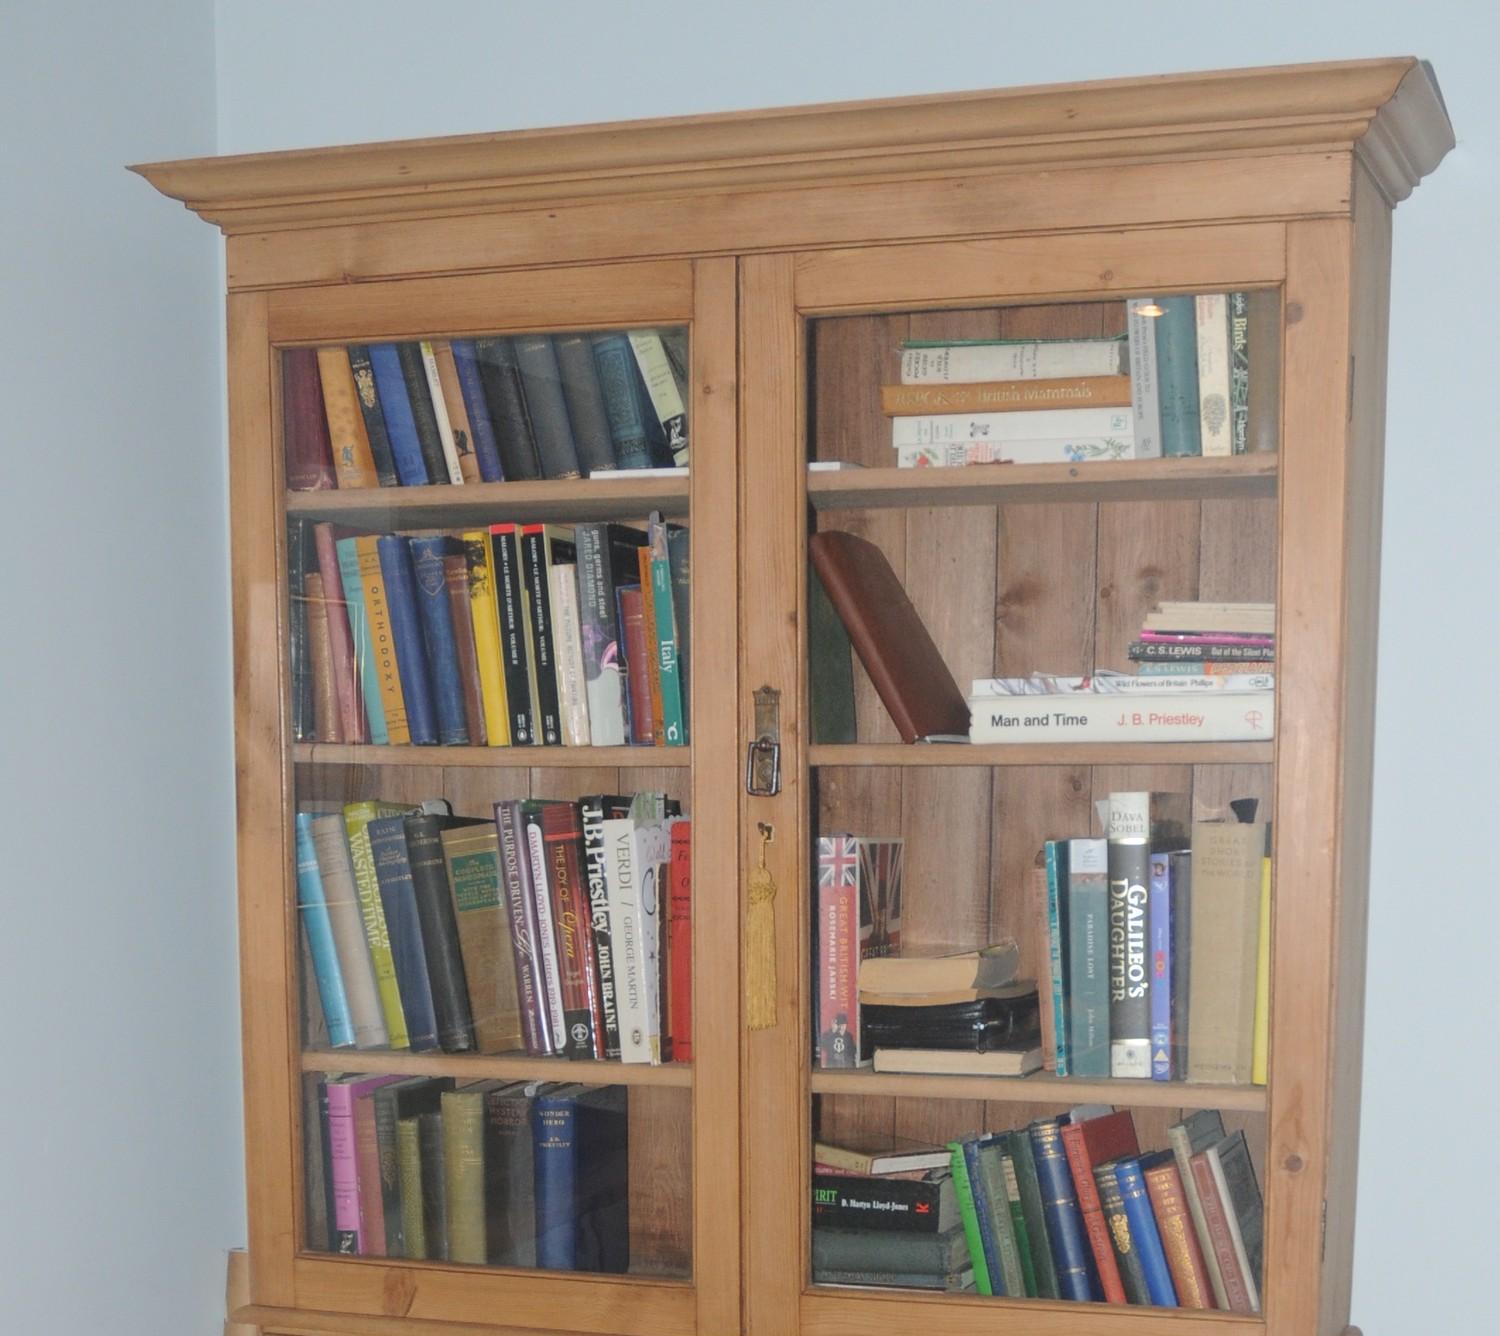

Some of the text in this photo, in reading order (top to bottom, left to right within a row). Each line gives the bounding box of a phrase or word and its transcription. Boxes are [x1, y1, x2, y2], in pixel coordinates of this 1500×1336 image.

[1233, 317, 1248, 351] Birds
[1024, 381, 1093, 401] Mammals
[582, 530, 597, 609] JARED DIAMOND
[591, 529, 600, 552] guns,
[599, 597, 608, 619] steel
[371, 586, 395, 694] ORTHODOXY
[661, 640, 674, 674] Italy
[1168, 646, 1203, 656] LEWIS
[1211, 646, 1222, 656] Out
[1231, 647, 1242, 656] the
[1131, 680, 1158, 688] Flowers
[1161, 664, 1199, 673] LEWIS
[990, 712, 1088, 728] Man and Time
[1117, 710, 1205, 728] J. B. Priestley
[501, 807, 511, 828] THE
[1109, 822, 1146, 834] SOBEL
[1111, 811, 1144, 823] DAVA
[504, 829, 518, 877] PURPOSE
[555, 845, 565, 863] THE
[616, 833, 633, 890] VERDI
[350, 831, 371, 901] WASTED
[363, 902, 380, 948] TIME
[557, 866, 567, 886] JOY
[509, 878, 523, 929] DRIVEN
[561, 887, 570, 904] OF
[557, 909, 579, 959] Opera
[624, 916, 637, 963] GEORGE
[1087, 913, 1095, 979] PARADISE LOST
[1110, 878, 1129, 1003] DAUGHTER
[1126, 884, 1149, 999] GALILEO'S
[597, 943, 612, 979] JOHN
[828, 904, 837, 1001] ROSEMARIE JARSKI
[839, 936, 849, 984] BRITISH
[522, 964, 533, 1003] WARREN
[627, 965, 639, 1010] MARTIN
[602, 981, 617, 1032] BRAINE
[539, 1110, 570, 1118] WONDER
[841, 1198, 849, 1208] D.
[850, 1198, 871, 1210] Martyn
[872, 1199, 909, 1212] Lloyd-Jones
